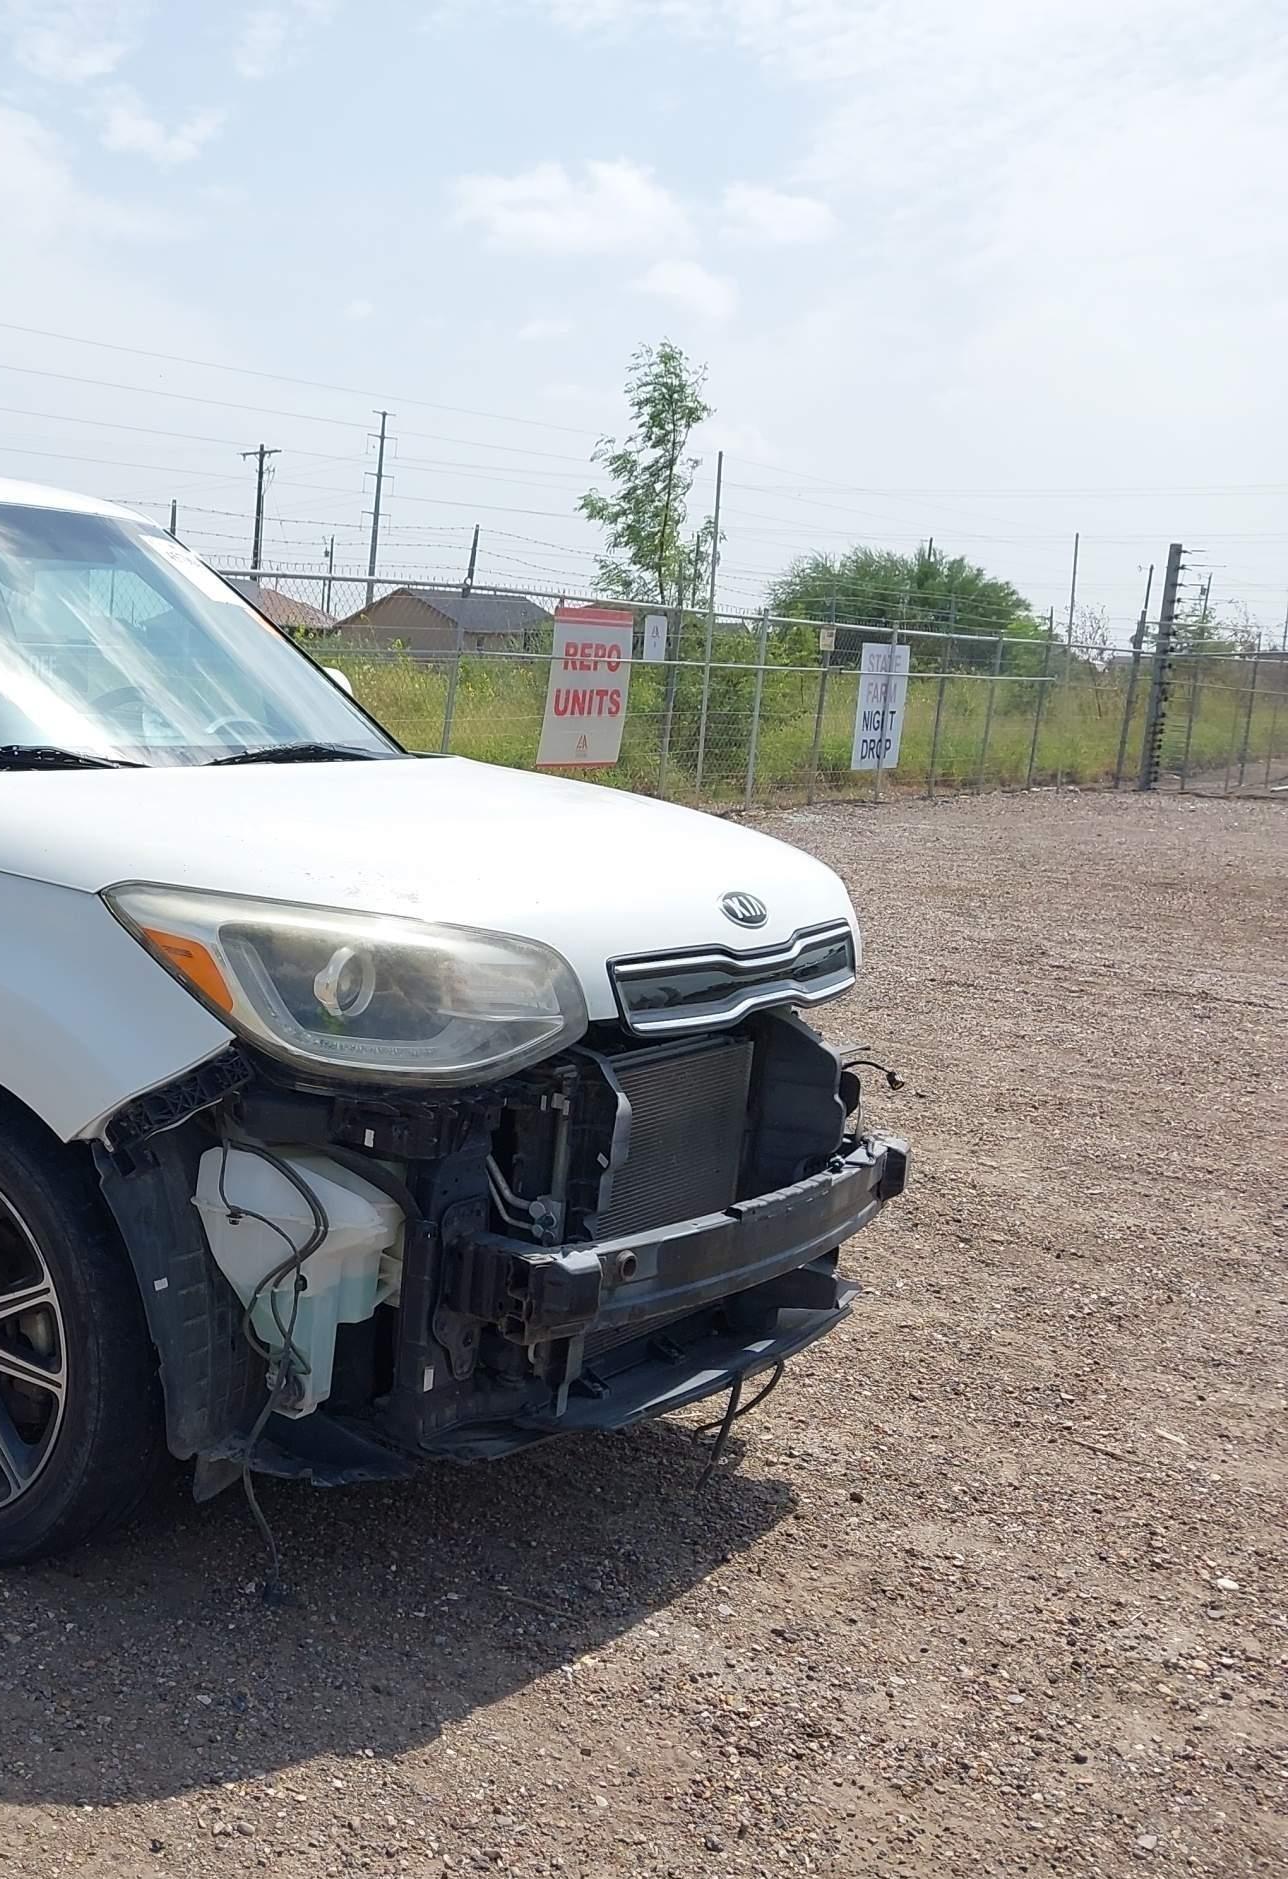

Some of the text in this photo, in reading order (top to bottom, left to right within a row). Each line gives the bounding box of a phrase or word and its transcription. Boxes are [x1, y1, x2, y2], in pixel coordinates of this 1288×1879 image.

[563, 641, 622, 673] REPO
[553, 688, 622, 717] UNITS
[723, 895, 767, 919] KIA
